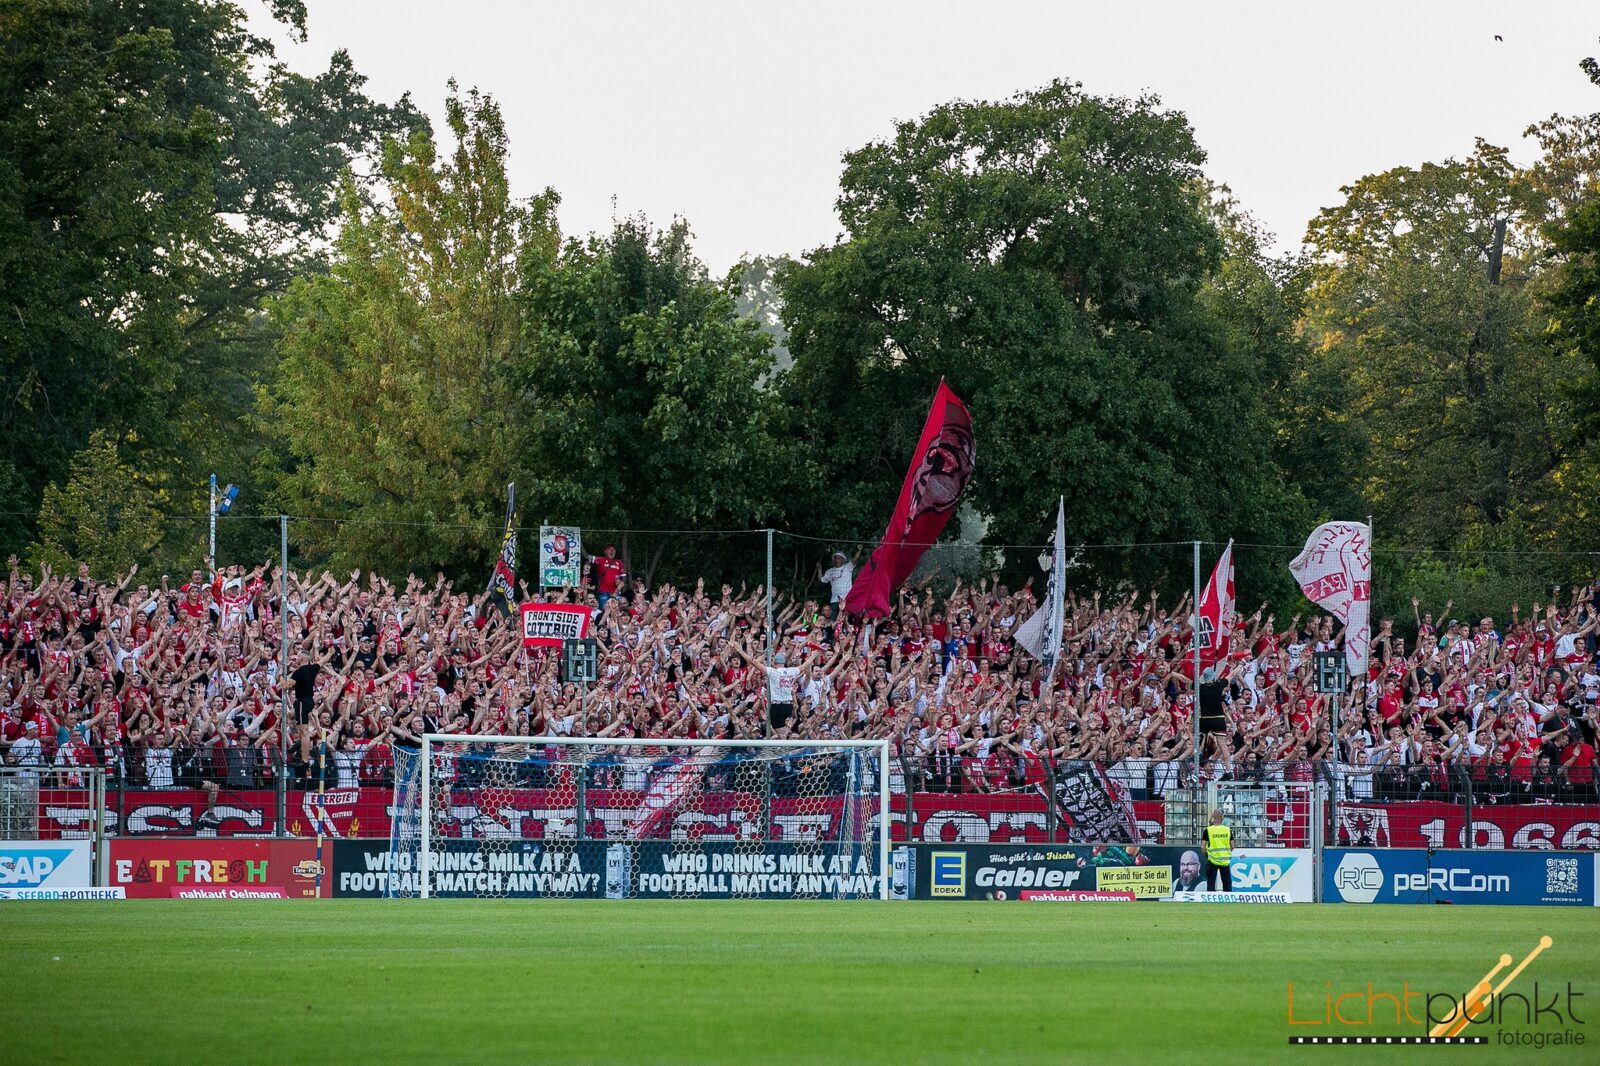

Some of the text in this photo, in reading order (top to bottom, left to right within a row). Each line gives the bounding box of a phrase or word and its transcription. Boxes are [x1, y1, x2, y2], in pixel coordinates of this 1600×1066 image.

[528, 611, 579, 625] FRONTSIDE
[526, 622, 577, 637] COTTBUS
[311, 793, 353, 804] EERGIE
[364, 852, 411, 871] WHO
[488, 853, 536, 872] MILK
[540, 853, 564, 872] AT
[568, 853, 582, 872] A
[662, 853, 868, 873] WHO DRINKS MILK AT A
[989, 851, 1076, 865] Hier gibt's die Frische
[0, 856, 54, 884] SAP
[176, 859, 268, 883] FRESH
[895, 862, 906, 870] LY!
[436, 872, 502, 892] MATCH
[507, 873, 600, 892] ANYWAY?
[975, 867, 1080, 887] Gabler
[1102, 870, 1167, 880] Wir sind für Sie da!
[1231, 863, 1281, 888] SAP
[1394, 868, 1510, 896] peRCom
[640, 873, 881, 893] FOOTBALL MATCH ANYWAY
[1158, 885, 1170, 894] Uhr
[17, 890, 119, 899] SEEBAD-APOTHEKE
[179, 889, 281, 899] nahkauf Oelmann
[1029, 893, 1131, 901] nahkauf Oelmann
[1200, 894, 1287, 903] SEEBAD-APOTHEKE
